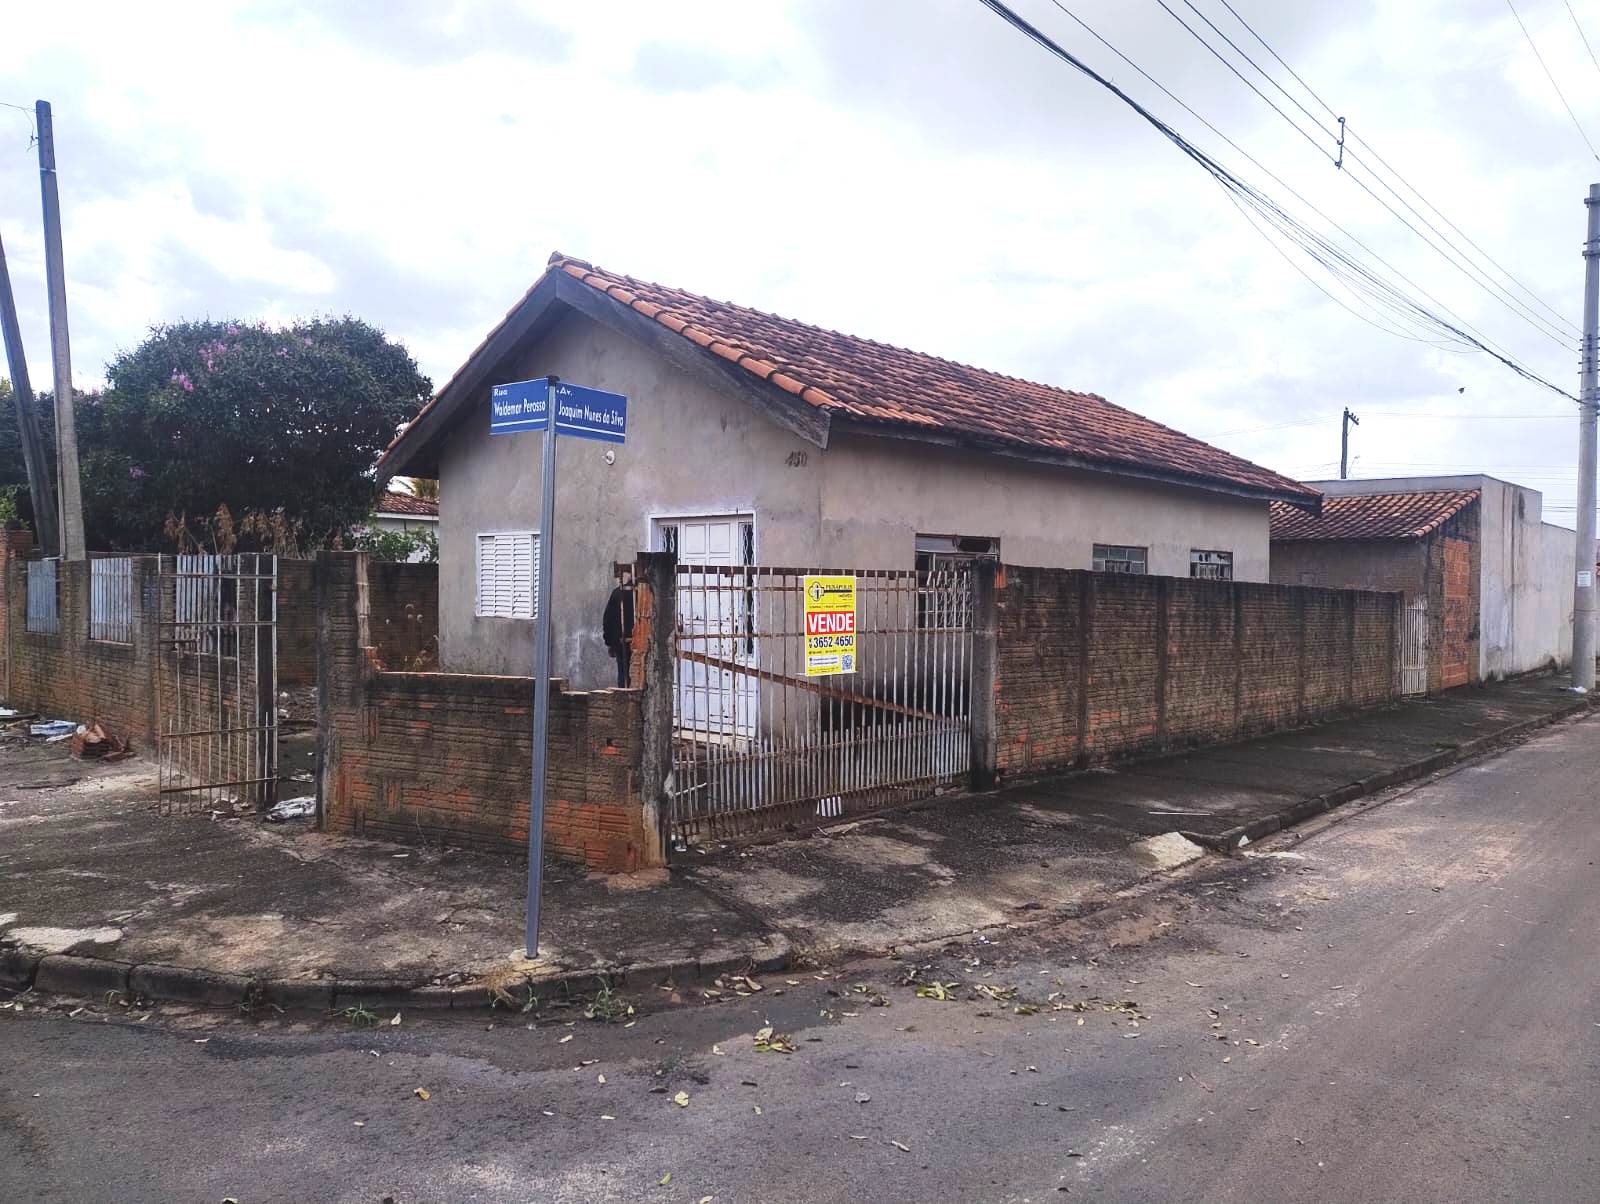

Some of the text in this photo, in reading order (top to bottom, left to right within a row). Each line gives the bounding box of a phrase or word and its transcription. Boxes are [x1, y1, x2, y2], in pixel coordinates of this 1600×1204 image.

[493, 388, 508, 397] Rua
[494, 398, 546, 417] Waldemar Perosso
[558, 400, 624, 428] Joaquim Nunes da Silva
[808, 613, 854, 633] VENDE
